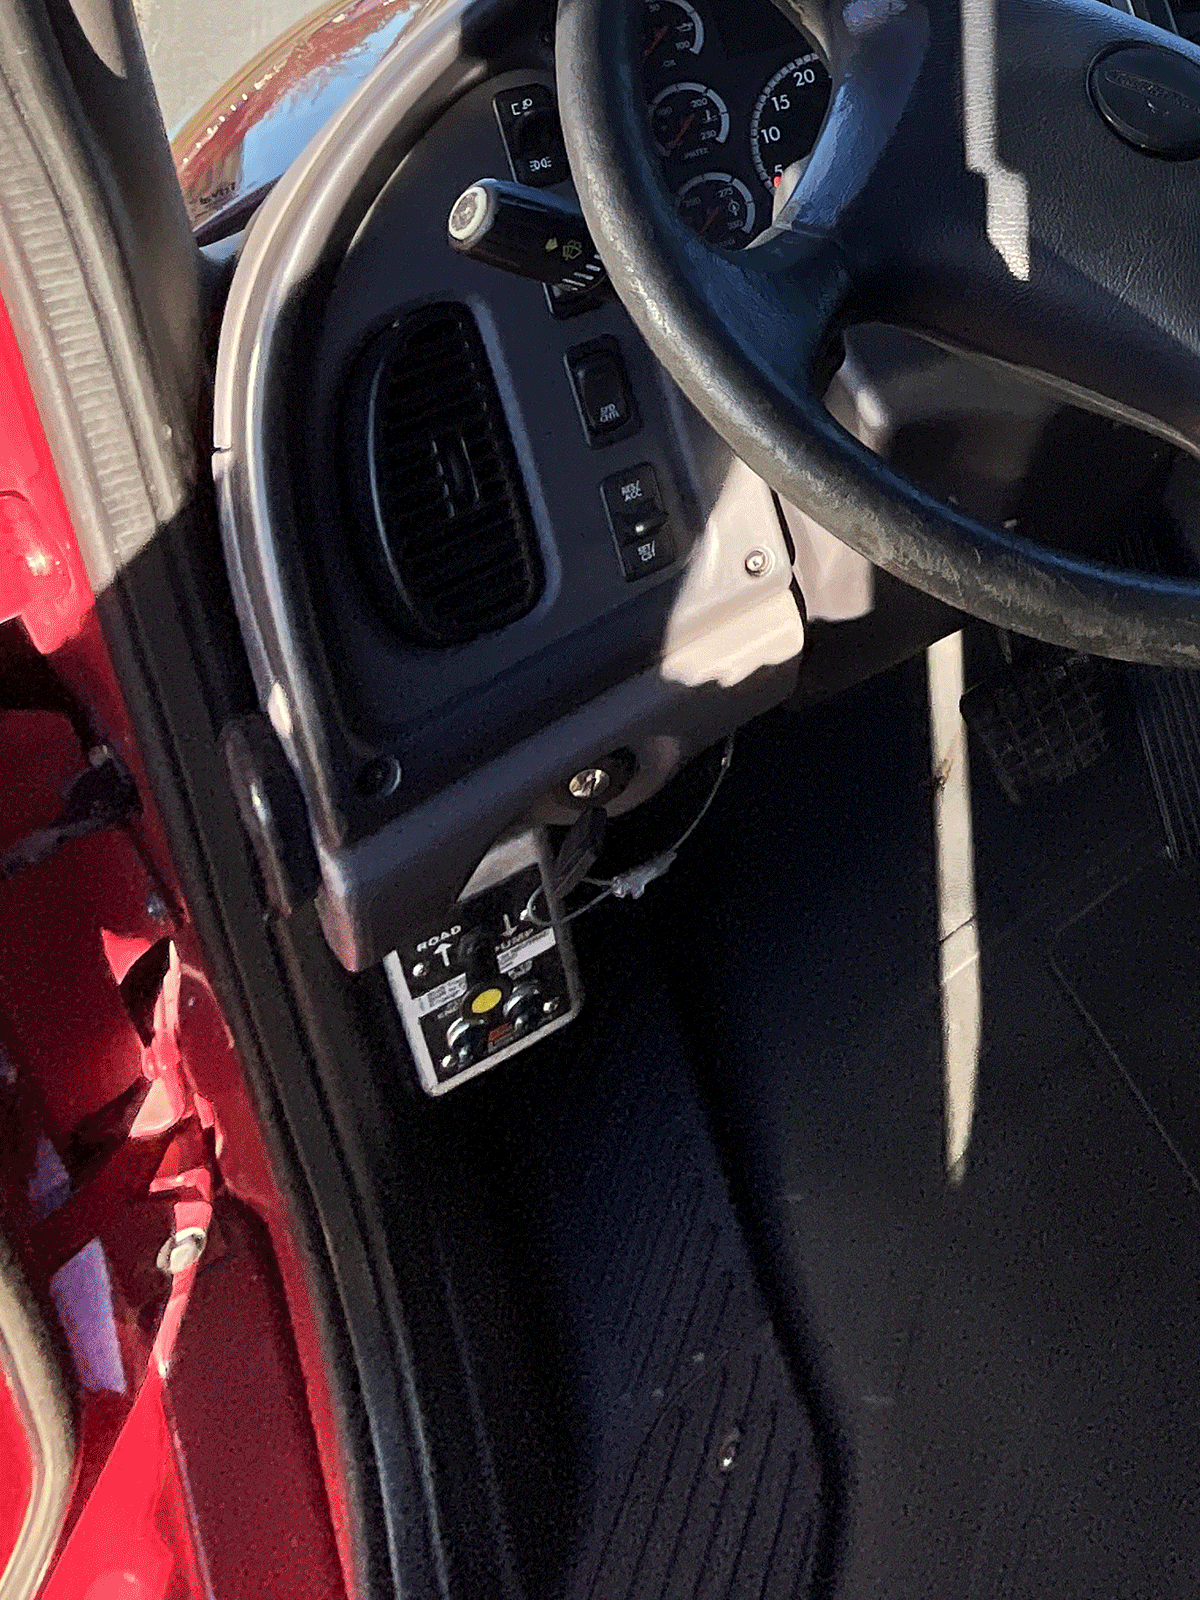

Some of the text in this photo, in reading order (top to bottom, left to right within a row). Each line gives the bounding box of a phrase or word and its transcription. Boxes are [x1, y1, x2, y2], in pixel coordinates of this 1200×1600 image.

[793, 68, 815, 87] 20
[771, 94, 791, 112] 15
[761, 126, 781, 144] 10
[774, 164, 784, 176] 5
[624, 491, 642, 502] ACC
[416, 924, 462, 952] ROAD
